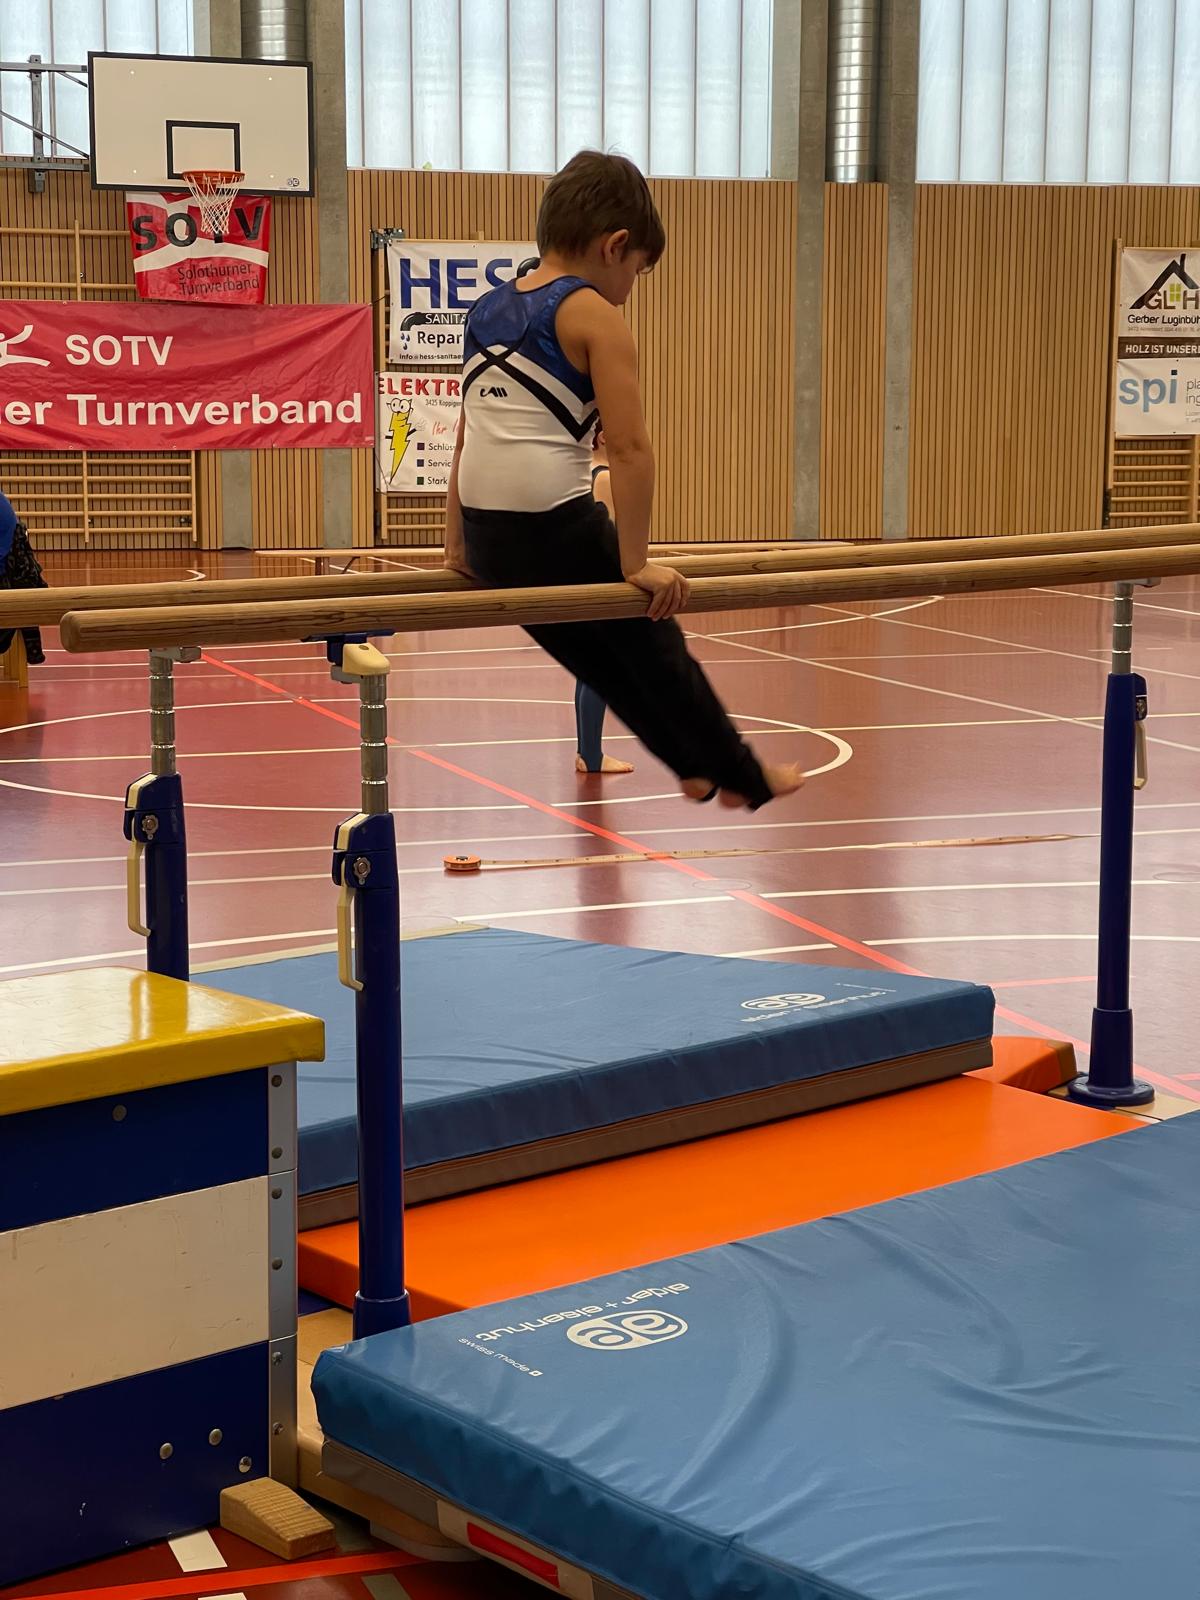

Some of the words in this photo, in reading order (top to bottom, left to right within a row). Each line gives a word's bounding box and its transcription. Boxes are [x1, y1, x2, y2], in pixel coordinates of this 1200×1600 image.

[177, 263, 252, 281] Solothurner
[180, 275, 260, 296] Turnverband
[1127, 314, 1160, 324] Gerber
[65, 334, 173, 366] SOTV
[417, 331, 462, 348] Repar
[1125, 344, 1150, 353] HOLZ
[1151, 345, 1165, 354] IST
[1119, 369, 1178, 413] spi
[0, 399, 52, 425] er
[66, 392, 362, 426] Turnverband
[427, 476, 448, 485] Stark
[621, 1282, 690, 1306] alder
[475, 1305, 603, 1341] eisenhut
[457, 1338, 494, 1356] swiss
[494, 1353, 530, 1372] made
